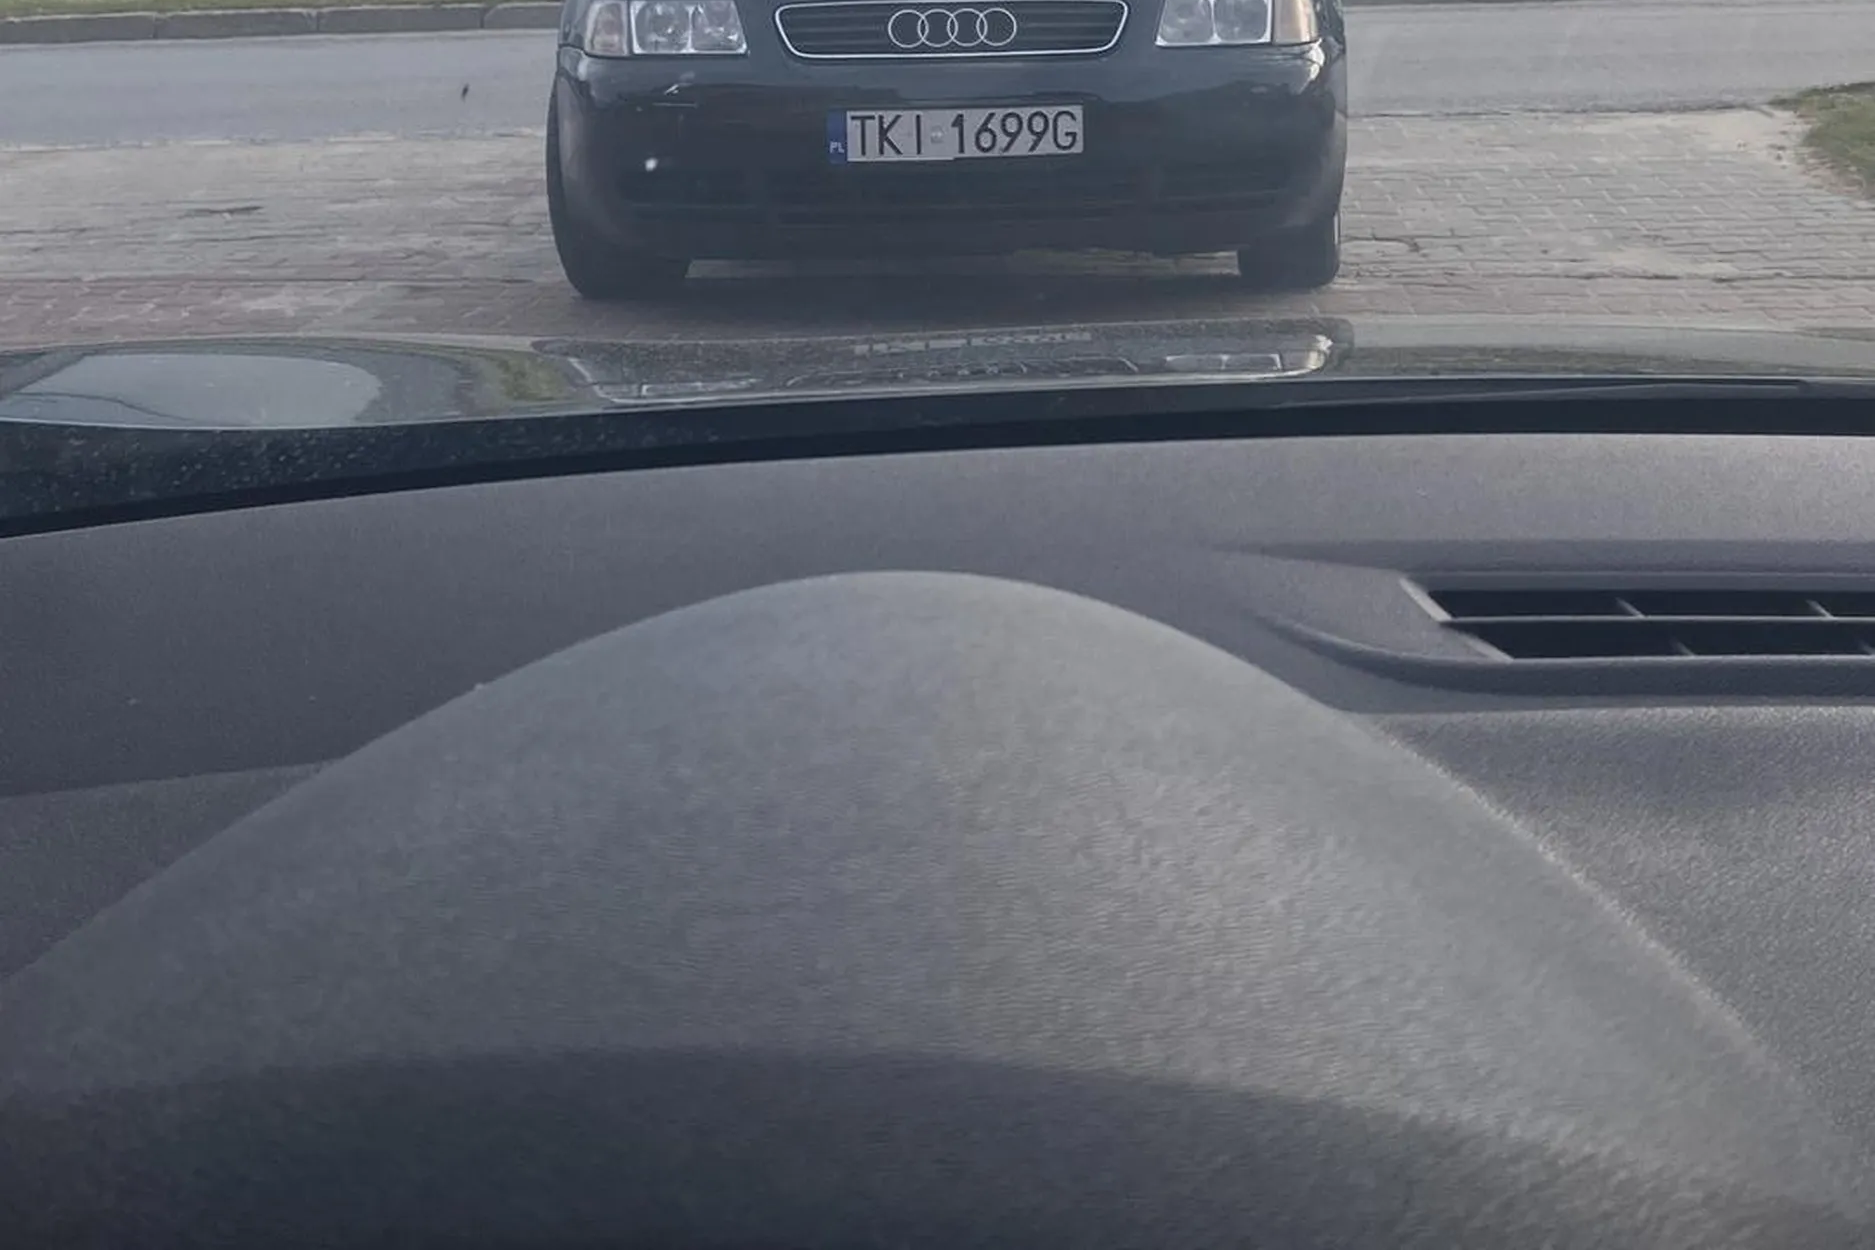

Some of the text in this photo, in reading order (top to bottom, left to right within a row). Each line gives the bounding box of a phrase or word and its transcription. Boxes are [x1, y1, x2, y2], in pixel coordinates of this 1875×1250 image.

[830, 141, 845, 154] PL
[850, 110, 1078, 156] TKI 1699G
